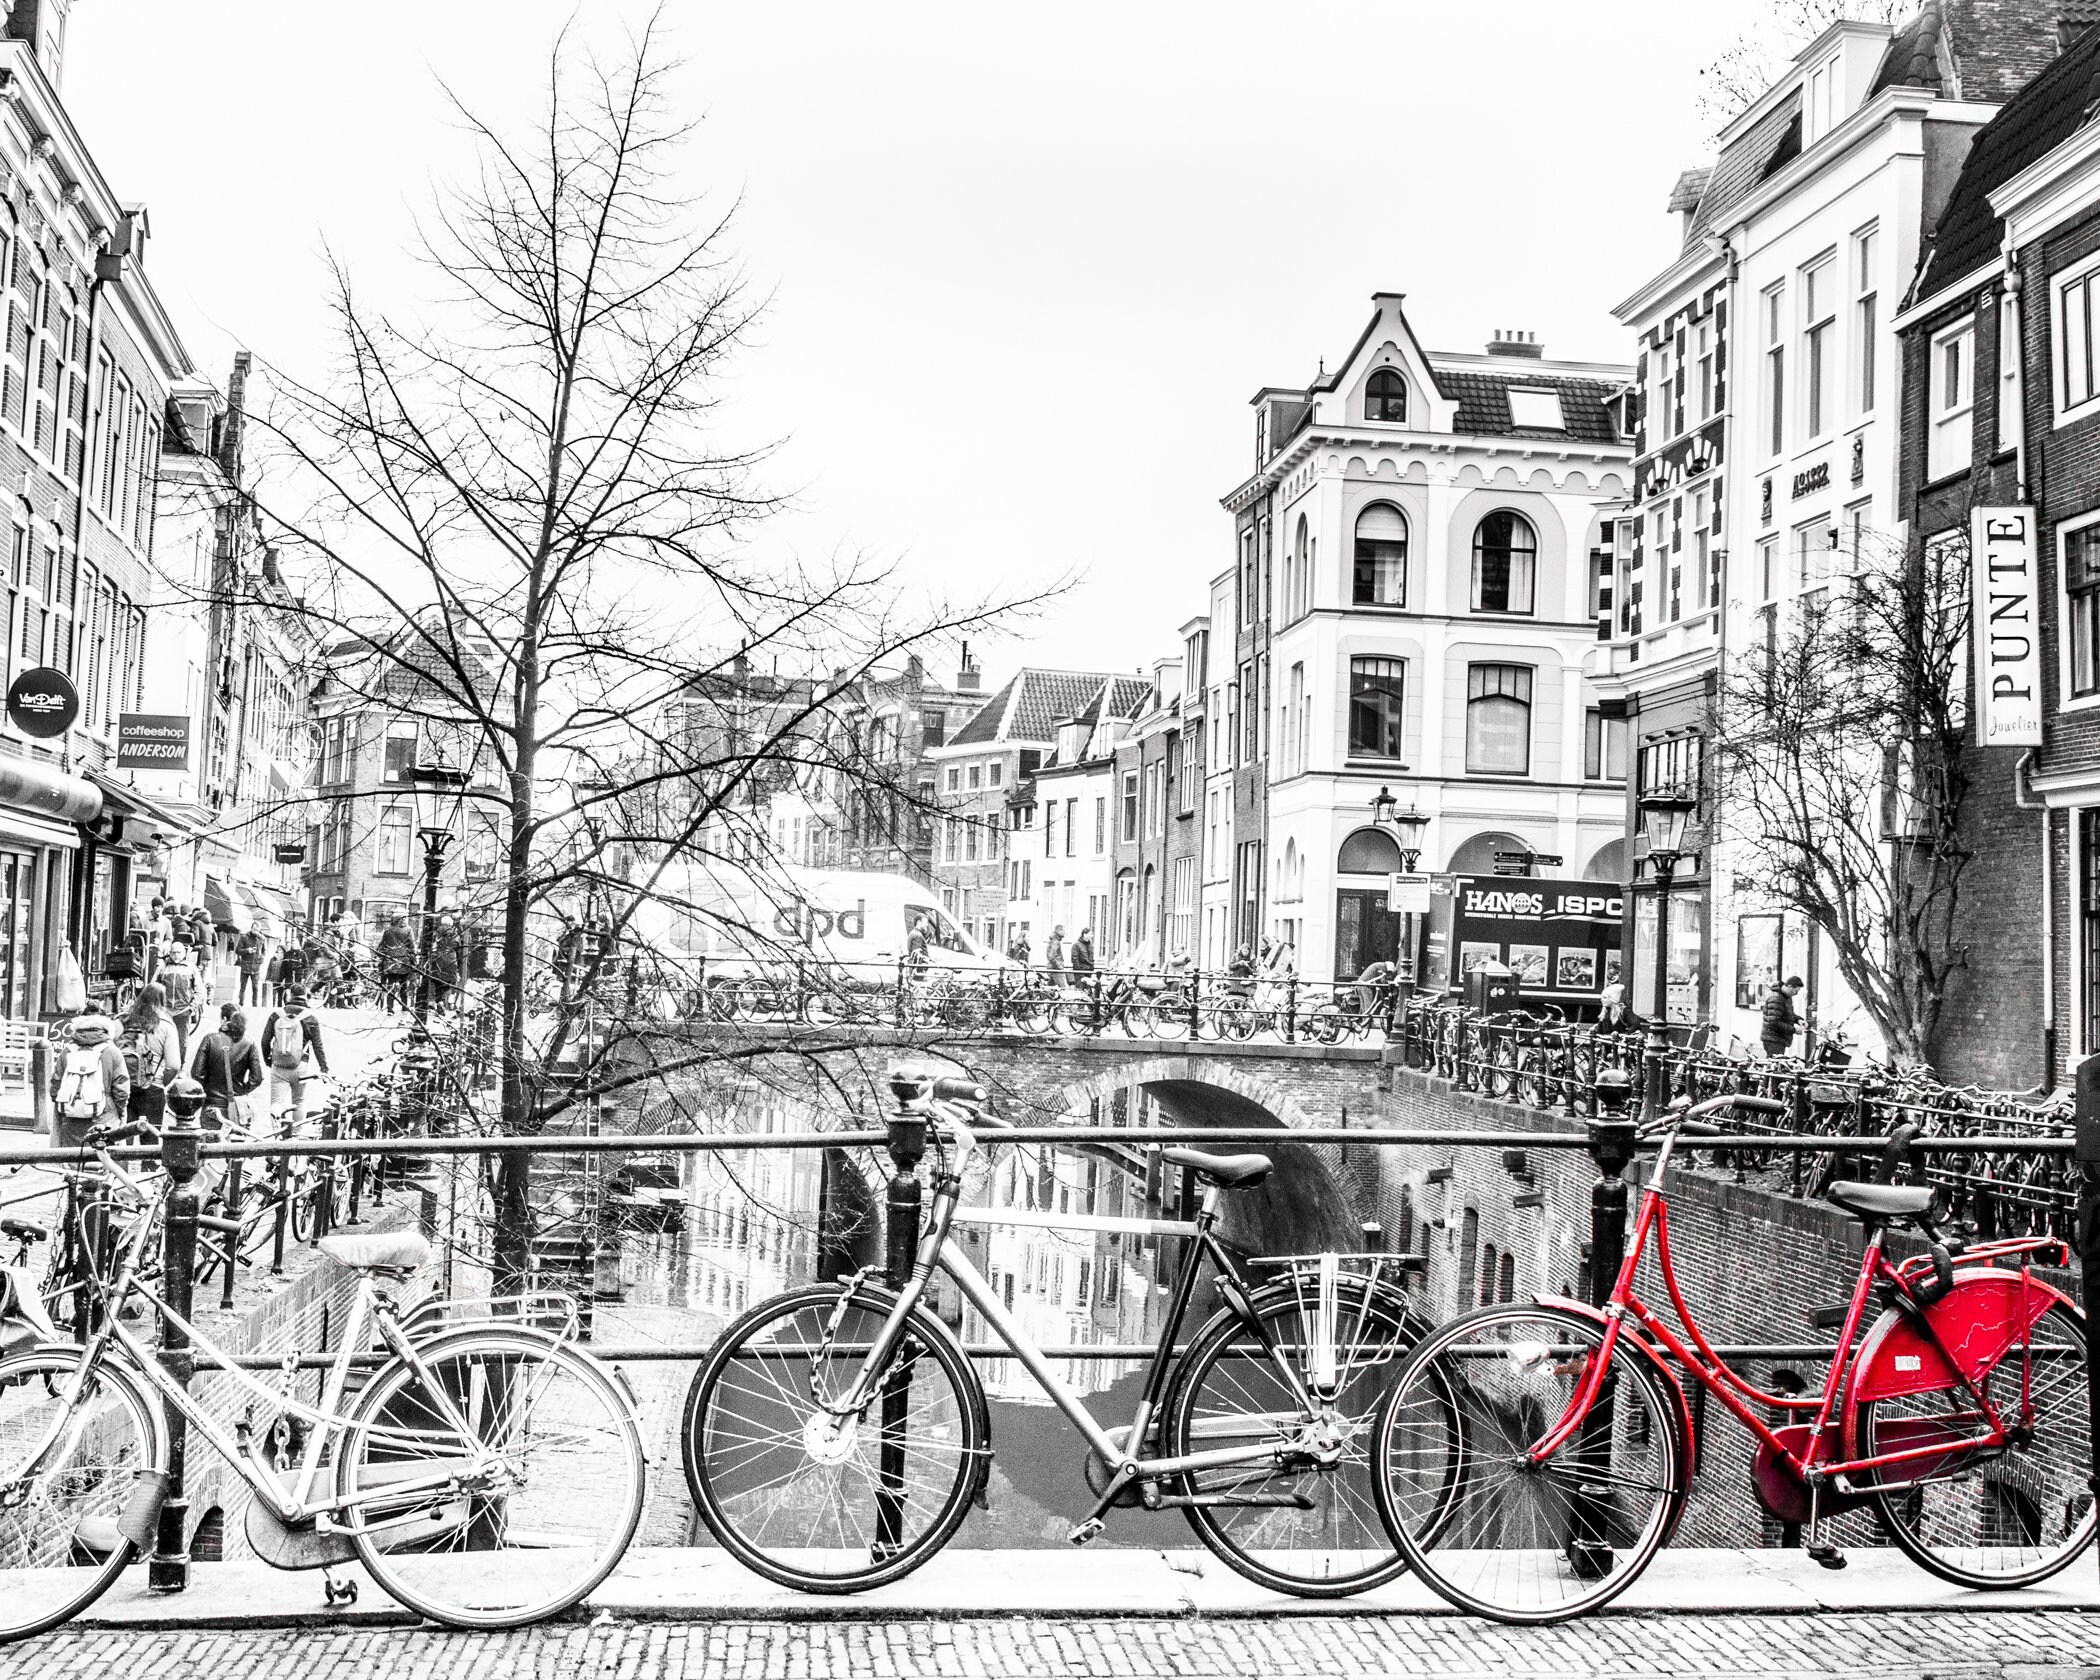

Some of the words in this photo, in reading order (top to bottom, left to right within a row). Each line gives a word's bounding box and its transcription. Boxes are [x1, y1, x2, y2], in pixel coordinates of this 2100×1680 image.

[1986, 515, 2031, 702] PUNTE
[122, 725, 185, 739] coffeeshop
[119, 742, 187, 759] ANDERSOM
[1464, 890, 1543, 915] HANOS
[1557, 895, 1623, 916] ISPC
[773, 897, 865, 948] dpd
